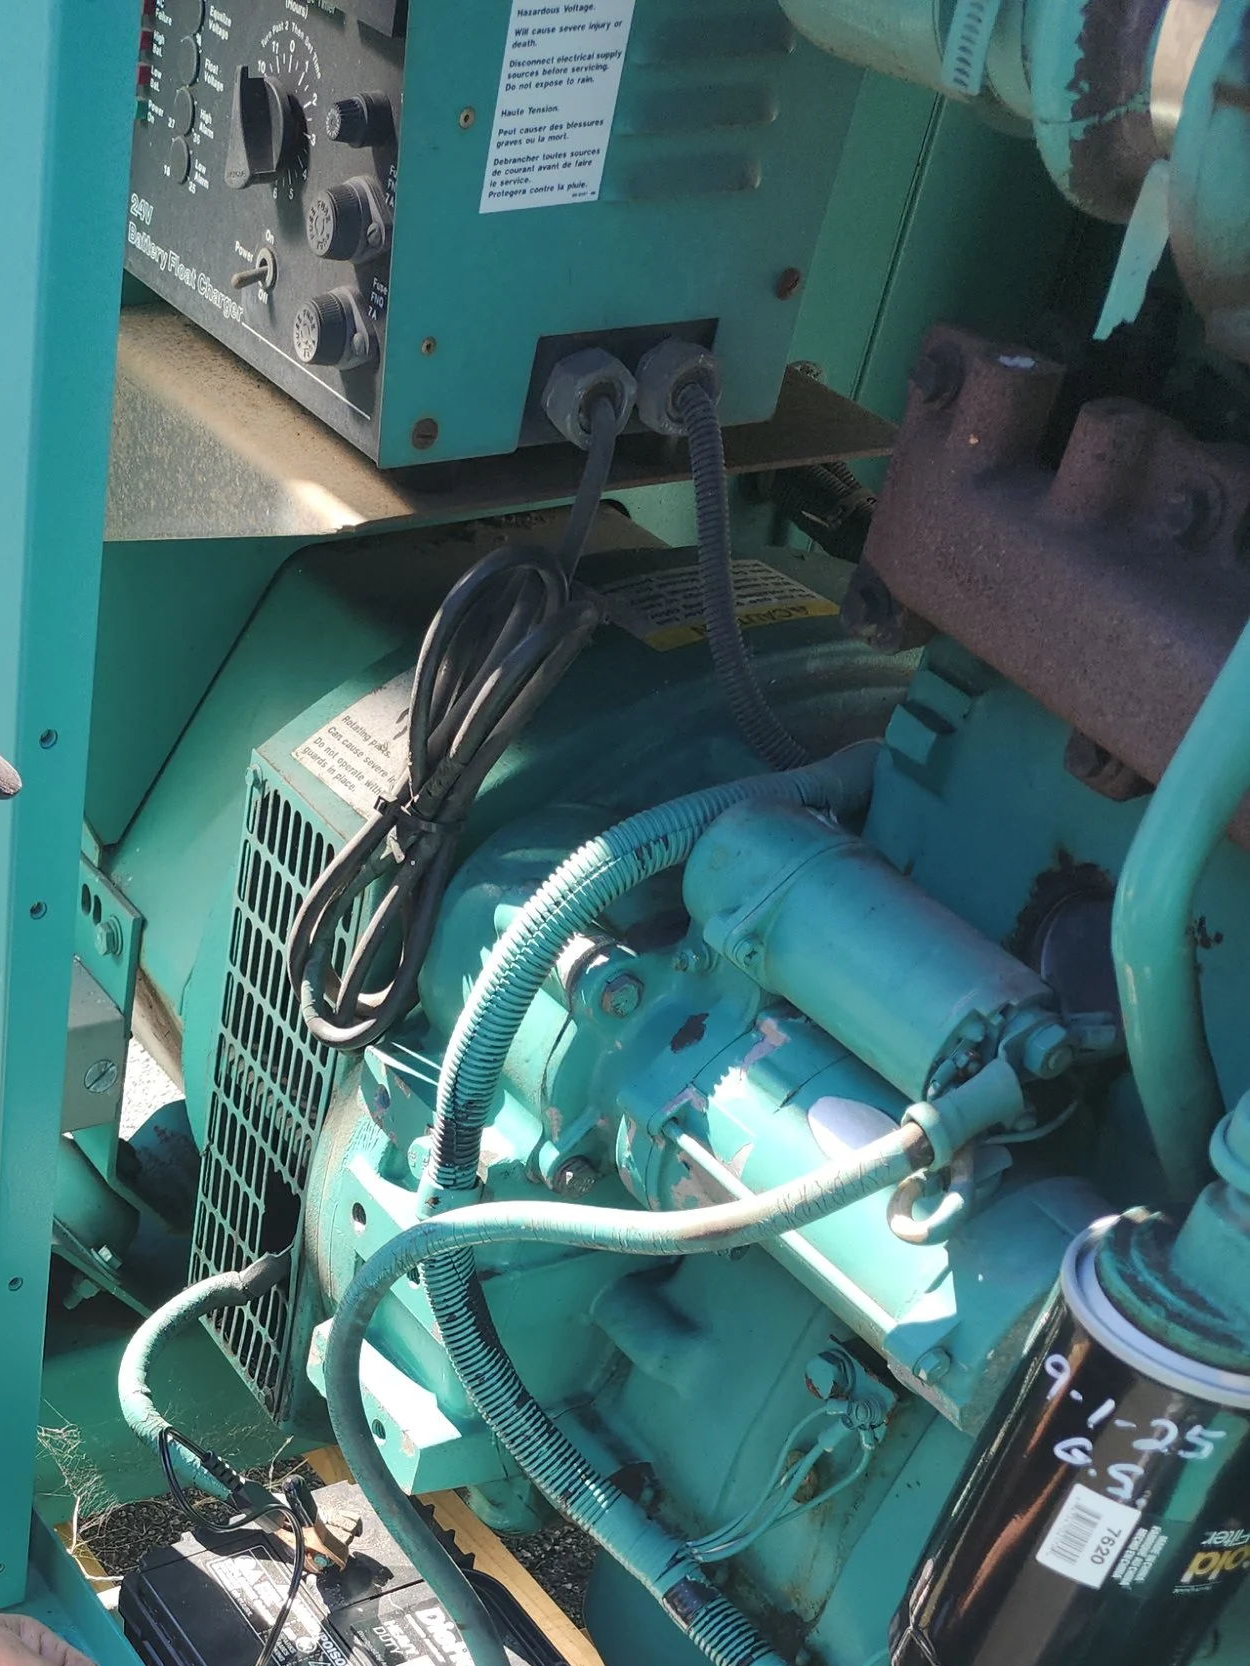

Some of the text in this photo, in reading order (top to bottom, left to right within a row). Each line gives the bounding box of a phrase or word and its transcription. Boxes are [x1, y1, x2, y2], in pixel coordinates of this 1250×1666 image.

[518, 3, 595, 17] Hazardous Voltage.
[285, 21, 289, 31] 2
[515, 20, 622, 36] Will cause severe injury or
[272, 41, 279, 54] 11
[290, 40, 295, 52] 0
[512, 40, 537, 49] death.
[258, 60, 266, 74] 10
[510, 49, 622, 68] Disconnect electrical supply
[508, 70, 539, 79] sources
[542, 66, 568, 76] before
[505, 75, 594, 92] Do not expose to rain.
[312, 93, 318, 106] 2
[501, 108, 524, 118] Haute
[498, 119, 603, 136] Peut causer des blessures
[310, 134, 316, 146] 3
[497, 139, 522, 149] graves
[538, 135, 545, 143] la
[548, 133, 569, 141] mort.
[494, 148, 600, 166] Debrancher toutes sources
[492, 158, 592, 177] de courant avant de faire
[488, 181, 587, 198] Protegera contre la pluie.
[500, 177, 531, 187] service.
[130, 193, 153, 225] 24V
[265, 229, 274, 244] On
[235, 240, 253, 263] Power
[128, 221, 168, 271] Battery
[168, 250, 196, 290] Float
[197, 273, 244, 322] Charger
[373, 277, 387, 295] Fuse
[368, 306, 377, 321] 7A
[342, 715, 371, 742] Rotating
[302, 746, 328, 768] guards
[327, 765, 336, 774] in
[314, 737, 325, 748] Do
[324, 746, 339, 758] not
[337, 757, 365, 781] operate
[328, 726, 388, 778] Can cause severe
[1090, 1527, 1122, 1566] 7620
[372, 1626, 403, 1653] DUTY
